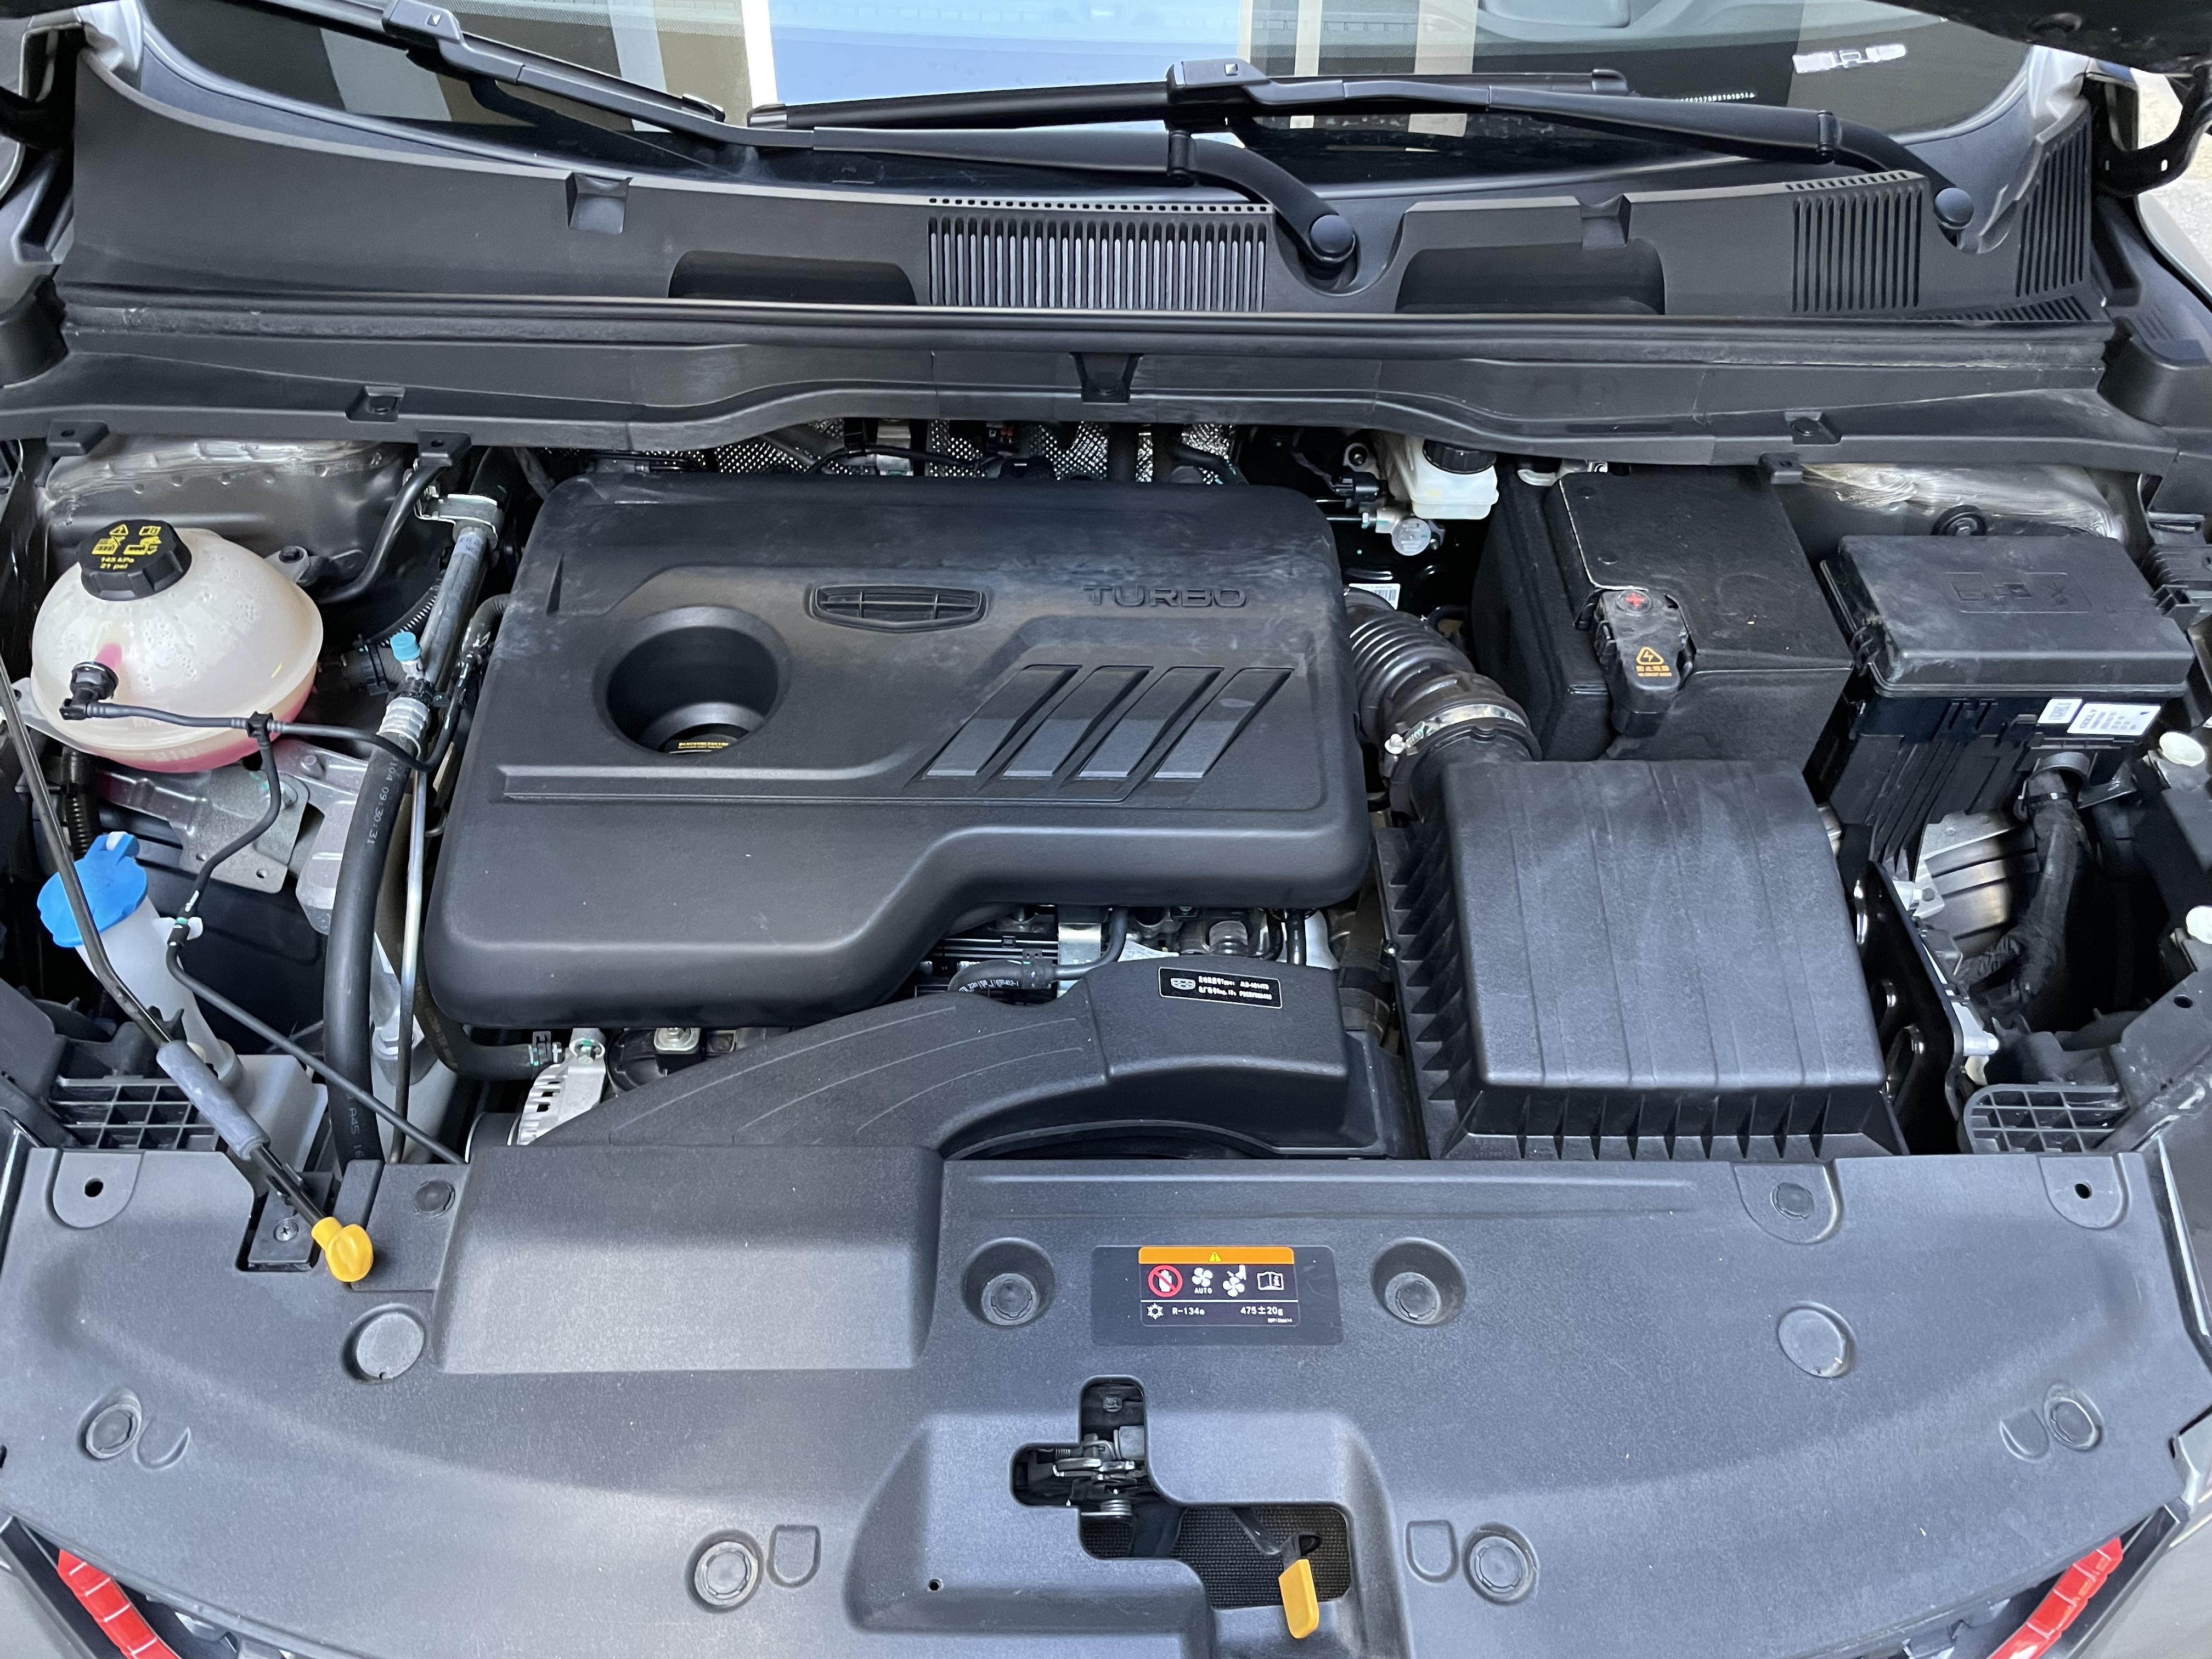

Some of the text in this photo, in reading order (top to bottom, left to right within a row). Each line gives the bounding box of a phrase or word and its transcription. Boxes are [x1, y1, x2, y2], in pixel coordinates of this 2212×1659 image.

[1083, 584, 1246, 608] TURBO
[367, 787, 390, 844] 09:30:31
[1172, 1307, 1205, 1315] R-134a
